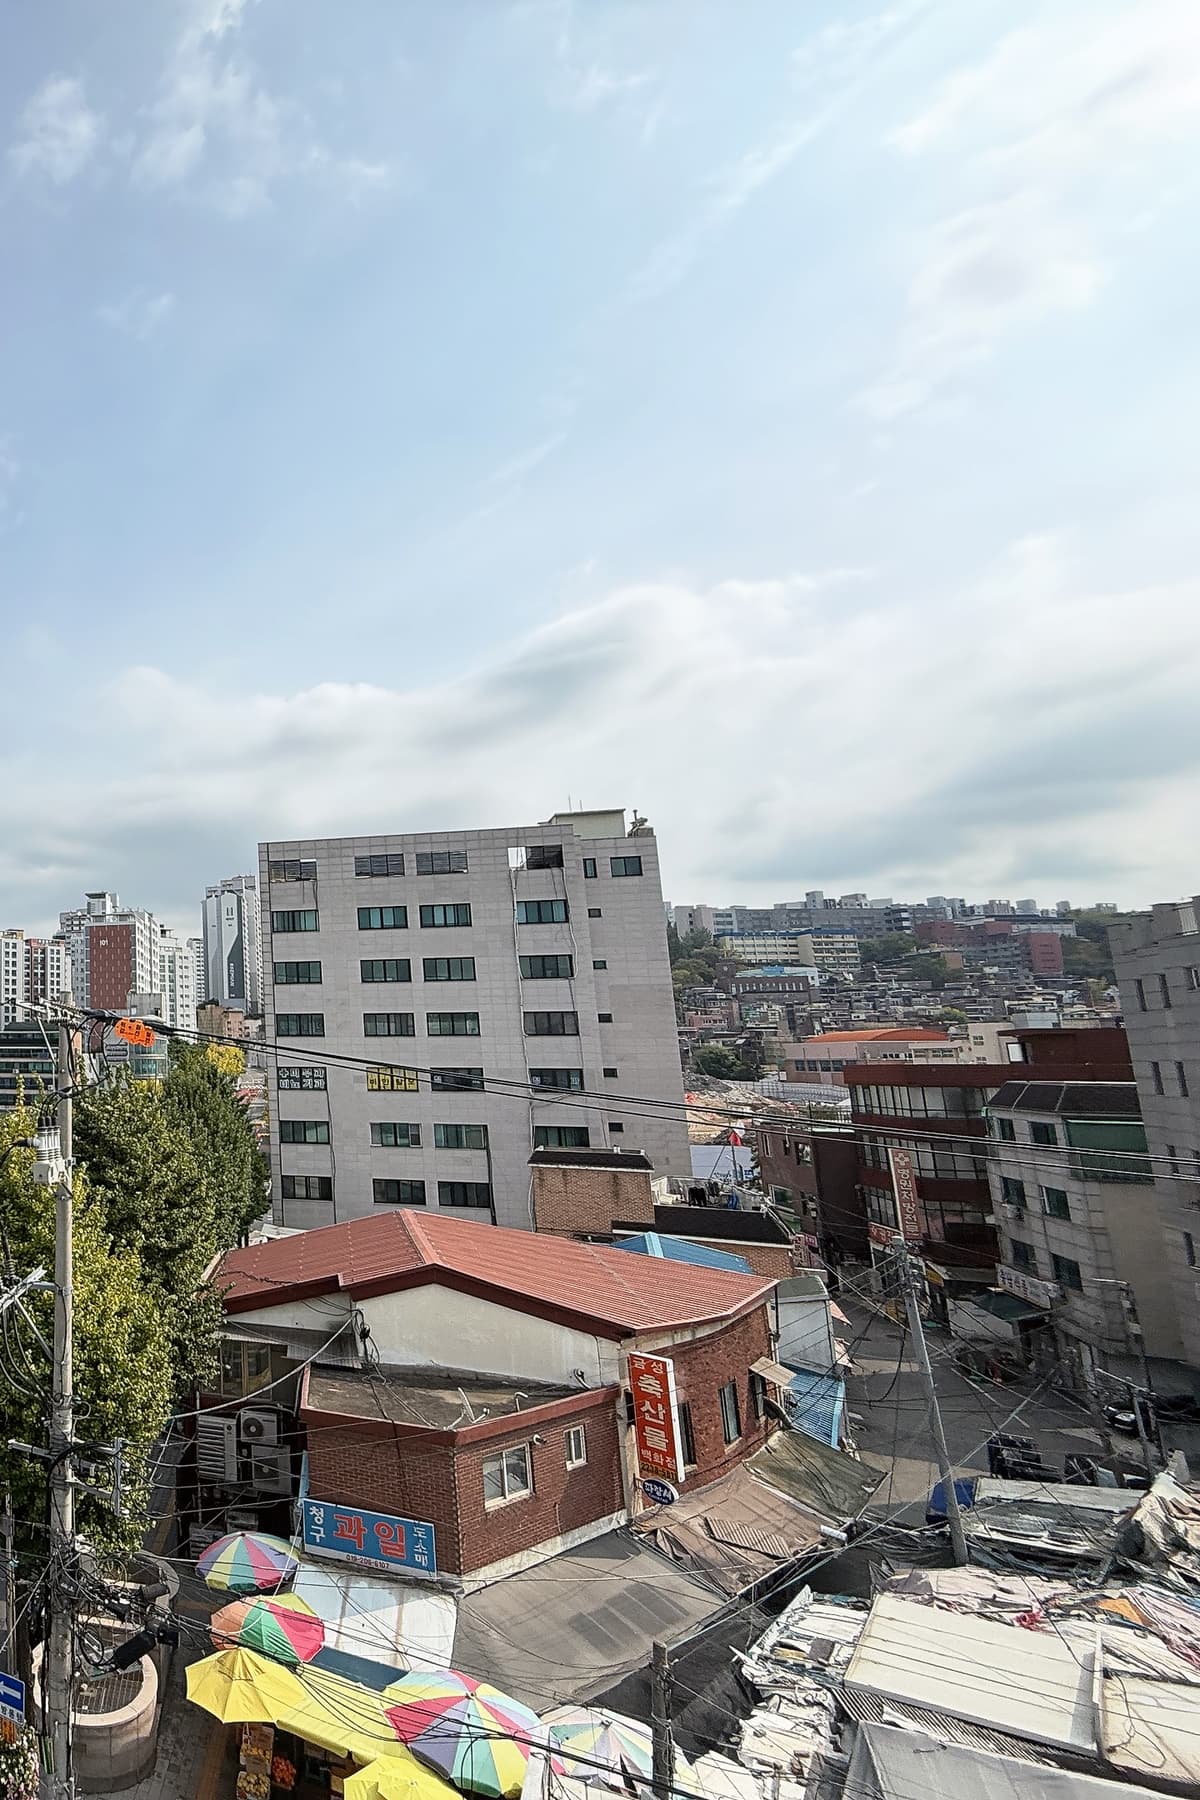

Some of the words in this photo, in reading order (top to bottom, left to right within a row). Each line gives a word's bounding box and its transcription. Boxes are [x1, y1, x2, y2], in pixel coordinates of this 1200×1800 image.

[633, 1357, 665, 1374] 금성
[638, 1374, 669, 1452] 축산물
[641, 1450, 676, 1470] 백화점
[309, 1506, 326, 1543] 청구
[333, 1514, 406, 1560] 과일
